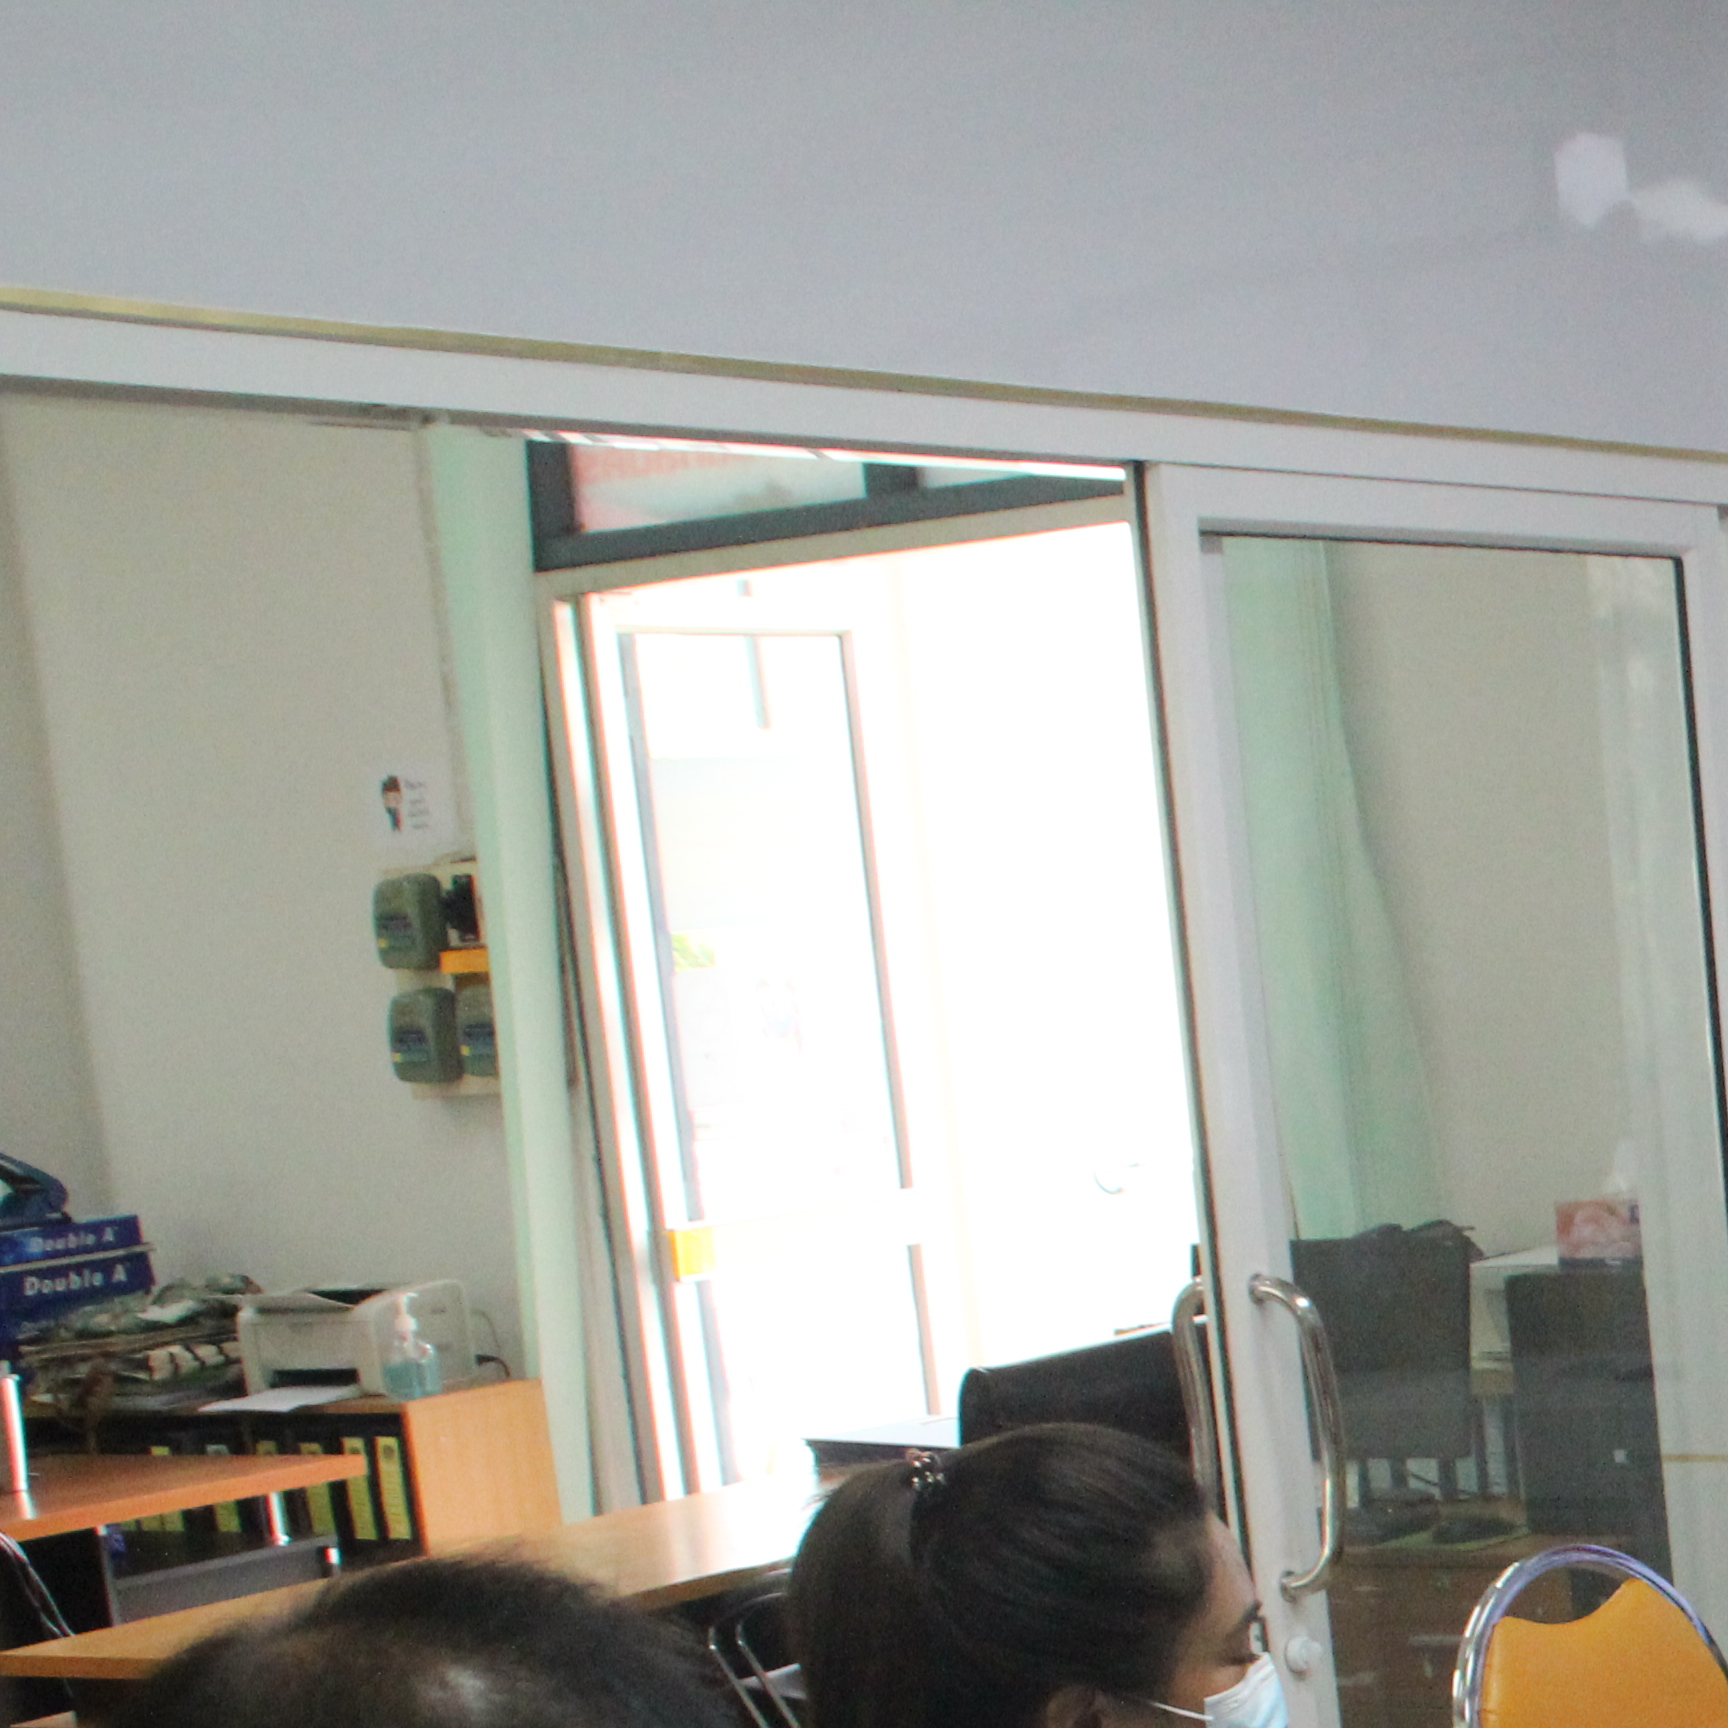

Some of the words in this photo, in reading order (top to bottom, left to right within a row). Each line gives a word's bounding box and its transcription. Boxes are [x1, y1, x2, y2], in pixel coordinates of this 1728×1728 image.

[28, 1232, 97, 1252] Double
[102, 1226, 115, 1242] A
[24, 1269, 104, 1296] Double
[111, 1263, 127, 1283] A
